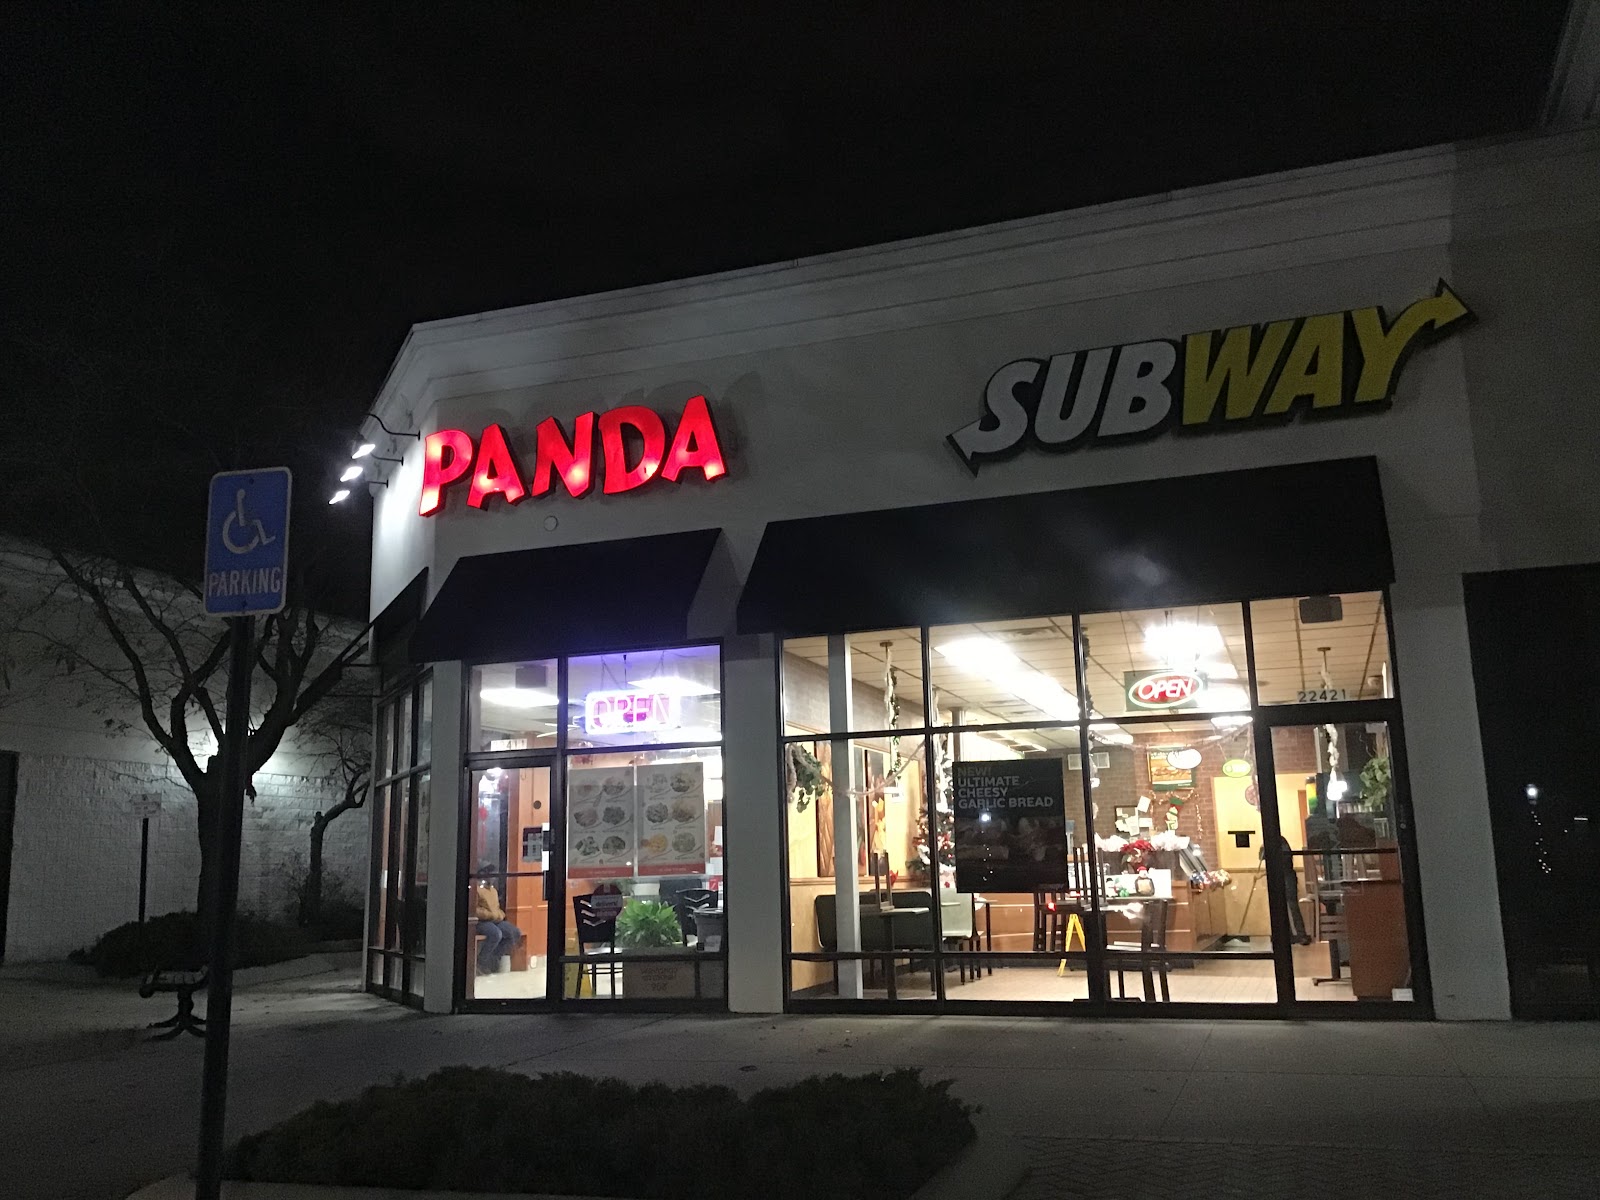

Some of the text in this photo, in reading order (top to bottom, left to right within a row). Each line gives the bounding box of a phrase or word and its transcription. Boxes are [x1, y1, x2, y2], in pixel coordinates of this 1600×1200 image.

[945, 279, 1476, 476] SUBWAY
[419, 395, 726, 516] PANDA
[208, 566, 281, 598] PARKING
[1138, 677, 1193, 700] OPEN
[1298, 688, 1346, 703] 22421
[593, 692, 672, 728] OPEN
[957, 766, 992, 777] NEW!
[957, 775, 1020, 788] ULTIMATE
[957, 787, 1008, 799] CHEESY
[958, 796, 1054, 809] GARLIC BREAD
